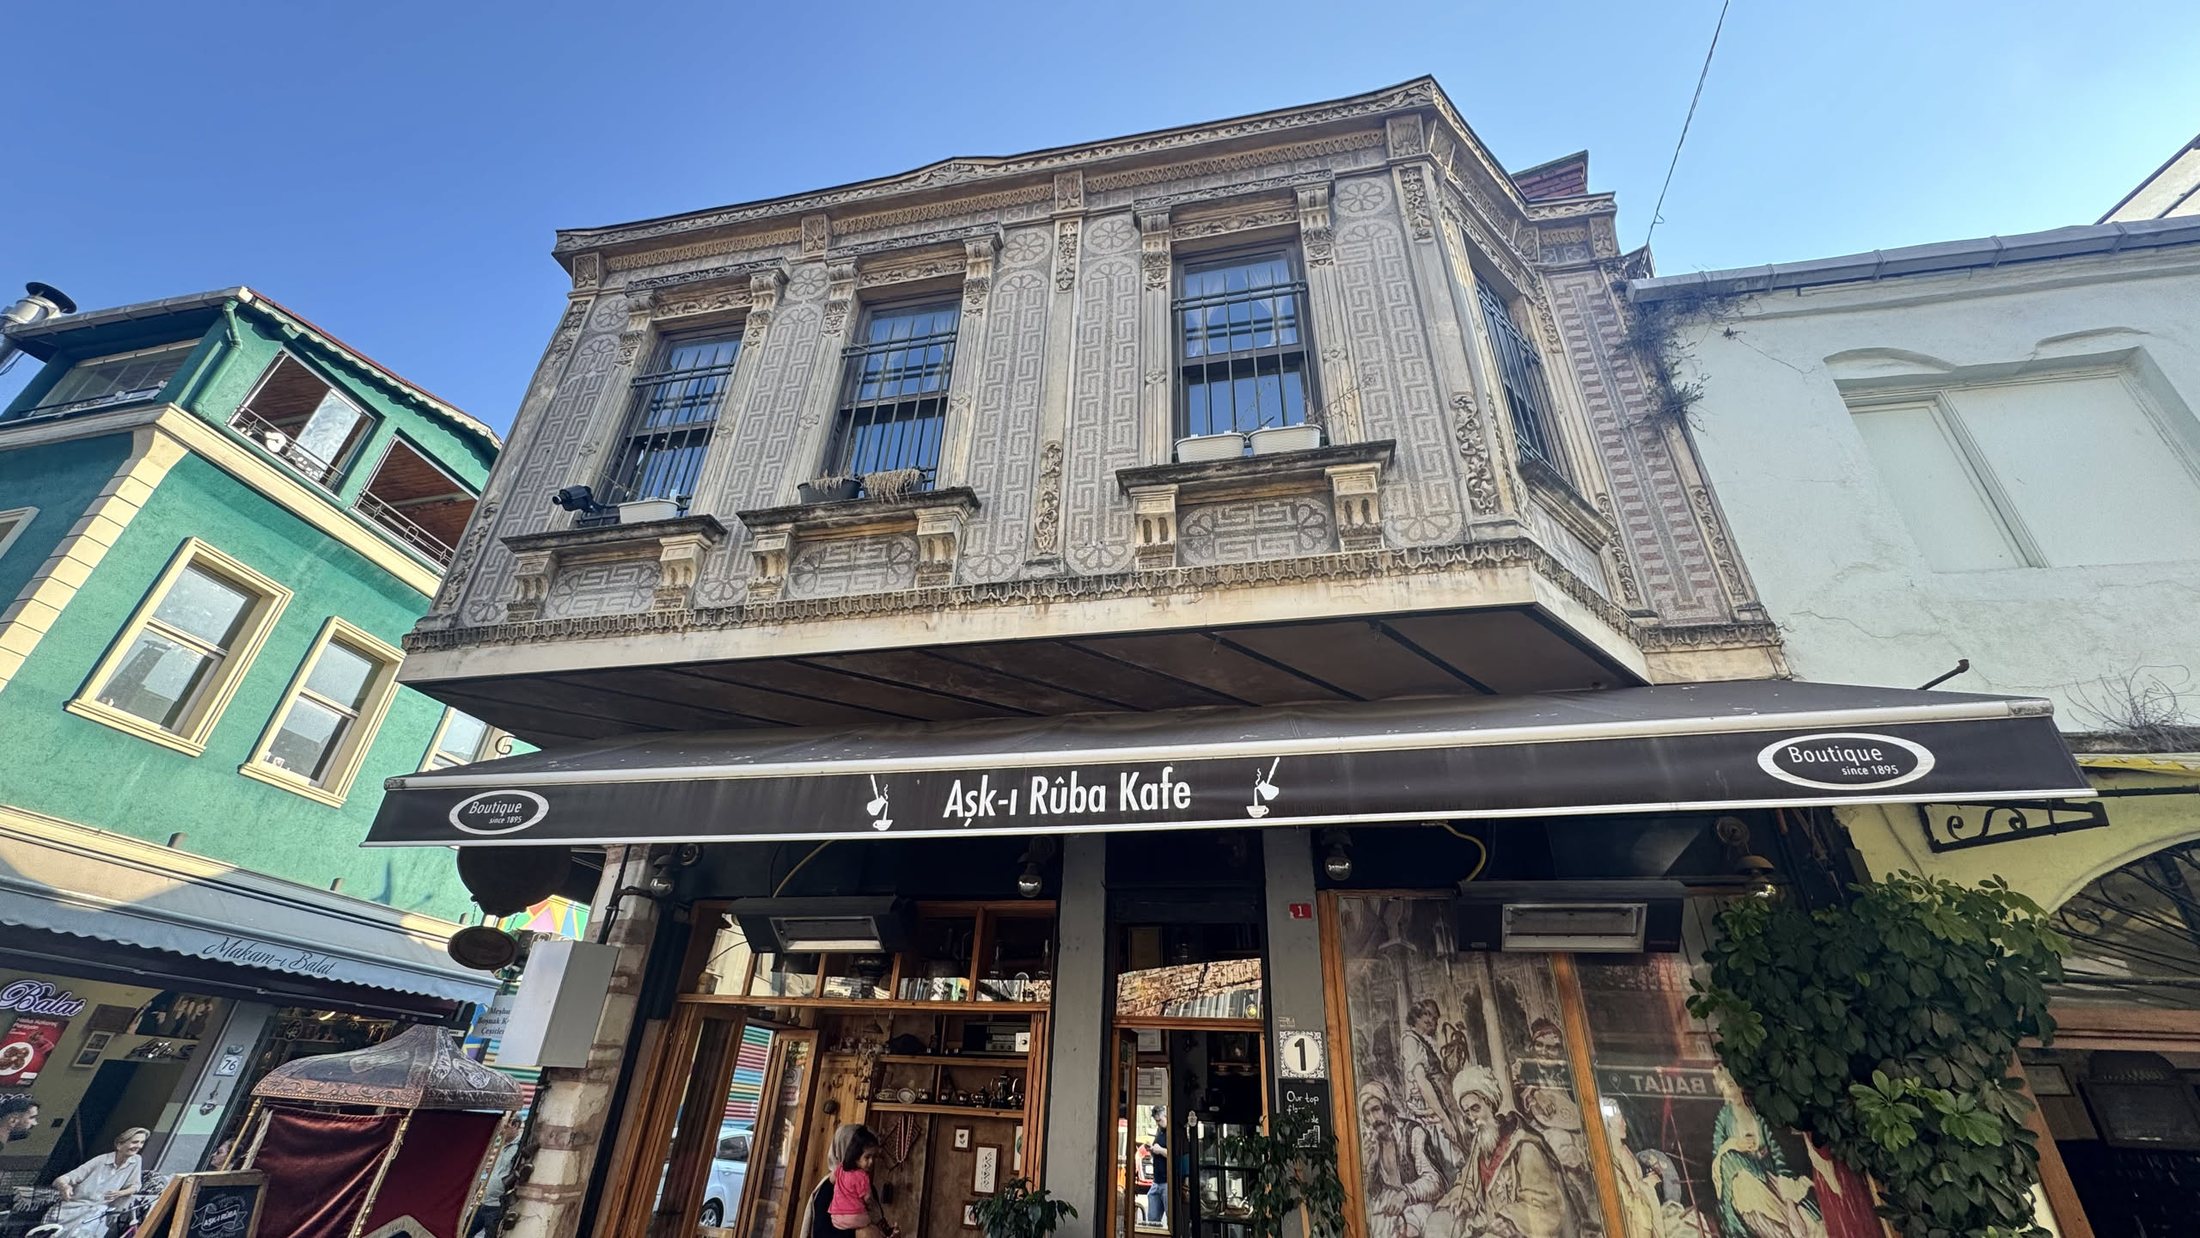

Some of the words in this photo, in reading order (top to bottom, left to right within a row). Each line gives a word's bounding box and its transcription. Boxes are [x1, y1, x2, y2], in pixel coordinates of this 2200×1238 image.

[1788, 745, 1883, 766] Boutique
[1841, 766, 1869, 776] since
[1871, 764, 1899, 775] 1895
[943, 775, 1018, 827] Aşk-ı
[1029, 771, 1106, 815] Rûba
[1119, 766, 1191, 811] Kafe
[468, 801, 522, 816] Boutique
[506, 816, 522, 824] 1895
[1298, 906, 1304, 917] 1
[203, 937, 288, 967] Makam-ı
[288, 951, 337, 975] Balat
[0, 980, 87, 1017] Balat
[1294, 1037, 1306, 1072] 1
[222, 1059, 237, 1070] 76
[1286, 1090, 1303, 1102] Our
[1304, 1092, 1320, 1106] top
